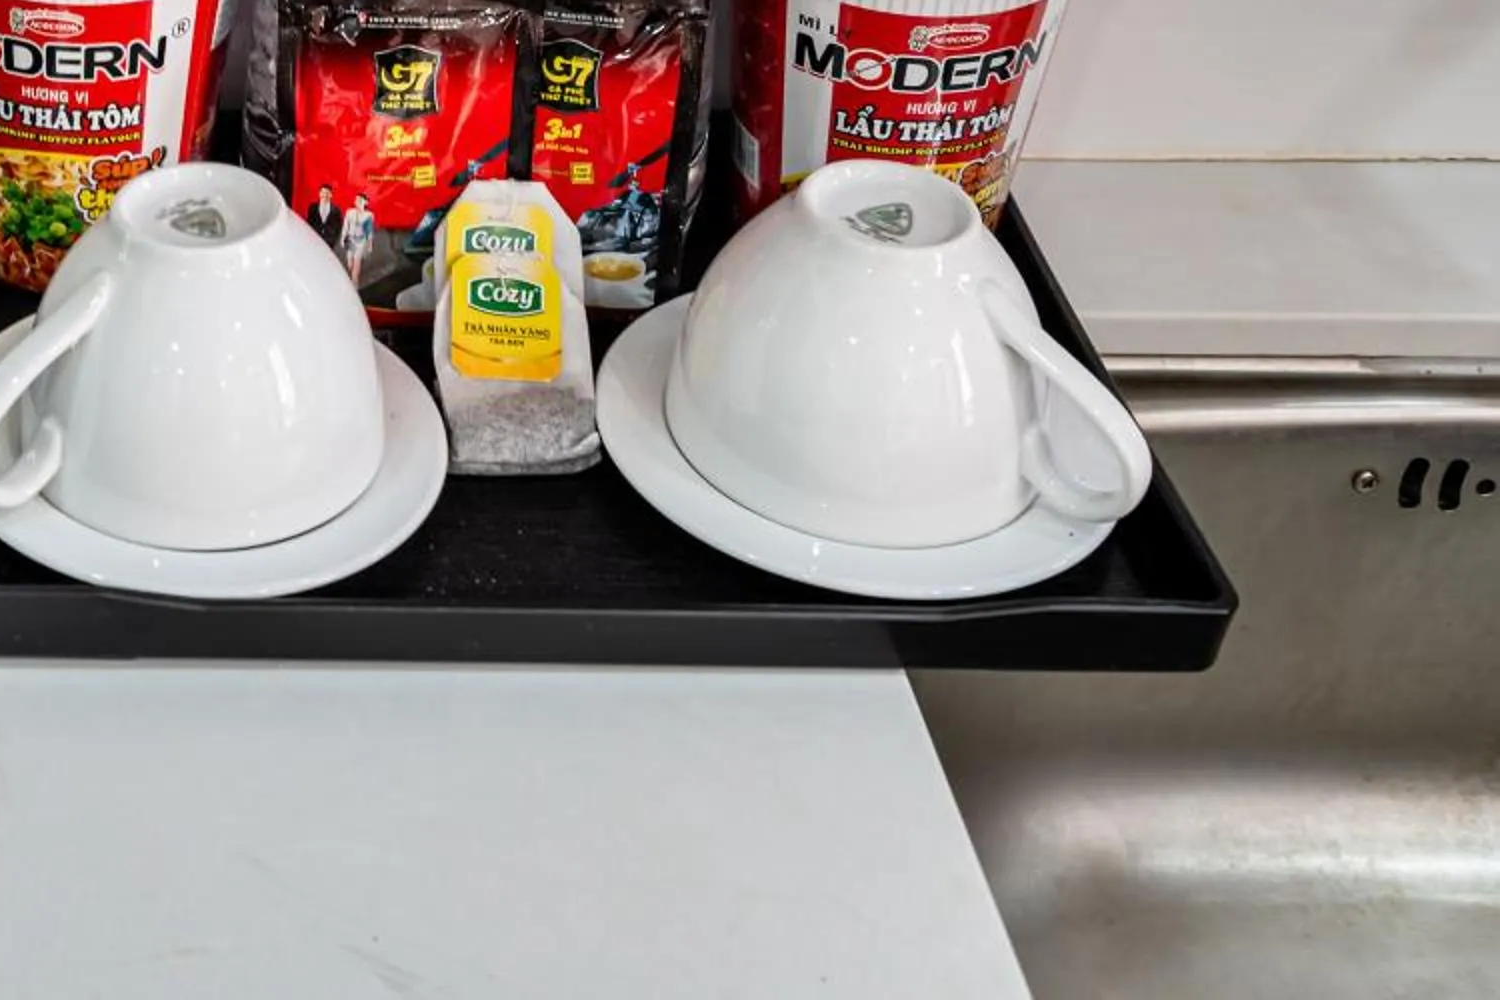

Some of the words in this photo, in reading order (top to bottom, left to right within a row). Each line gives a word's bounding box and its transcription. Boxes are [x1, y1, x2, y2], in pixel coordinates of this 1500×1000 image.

[381, 61, 434, 92] G7
[541, 55, 596, 87] G7
[794, 31, 1048, 92] MODERN
[19, 103, 82, 132] THÁI
[88, 103, 141, 132] TÔM
[835, 104, 894, 140] LẨU
[899, 116, 966, 142] THÁI
[39, 134, 84, 145] HOTPOT
[88, 132, 141, 145] FLAVOUR
[477, 281, 535, 310] Cozy
